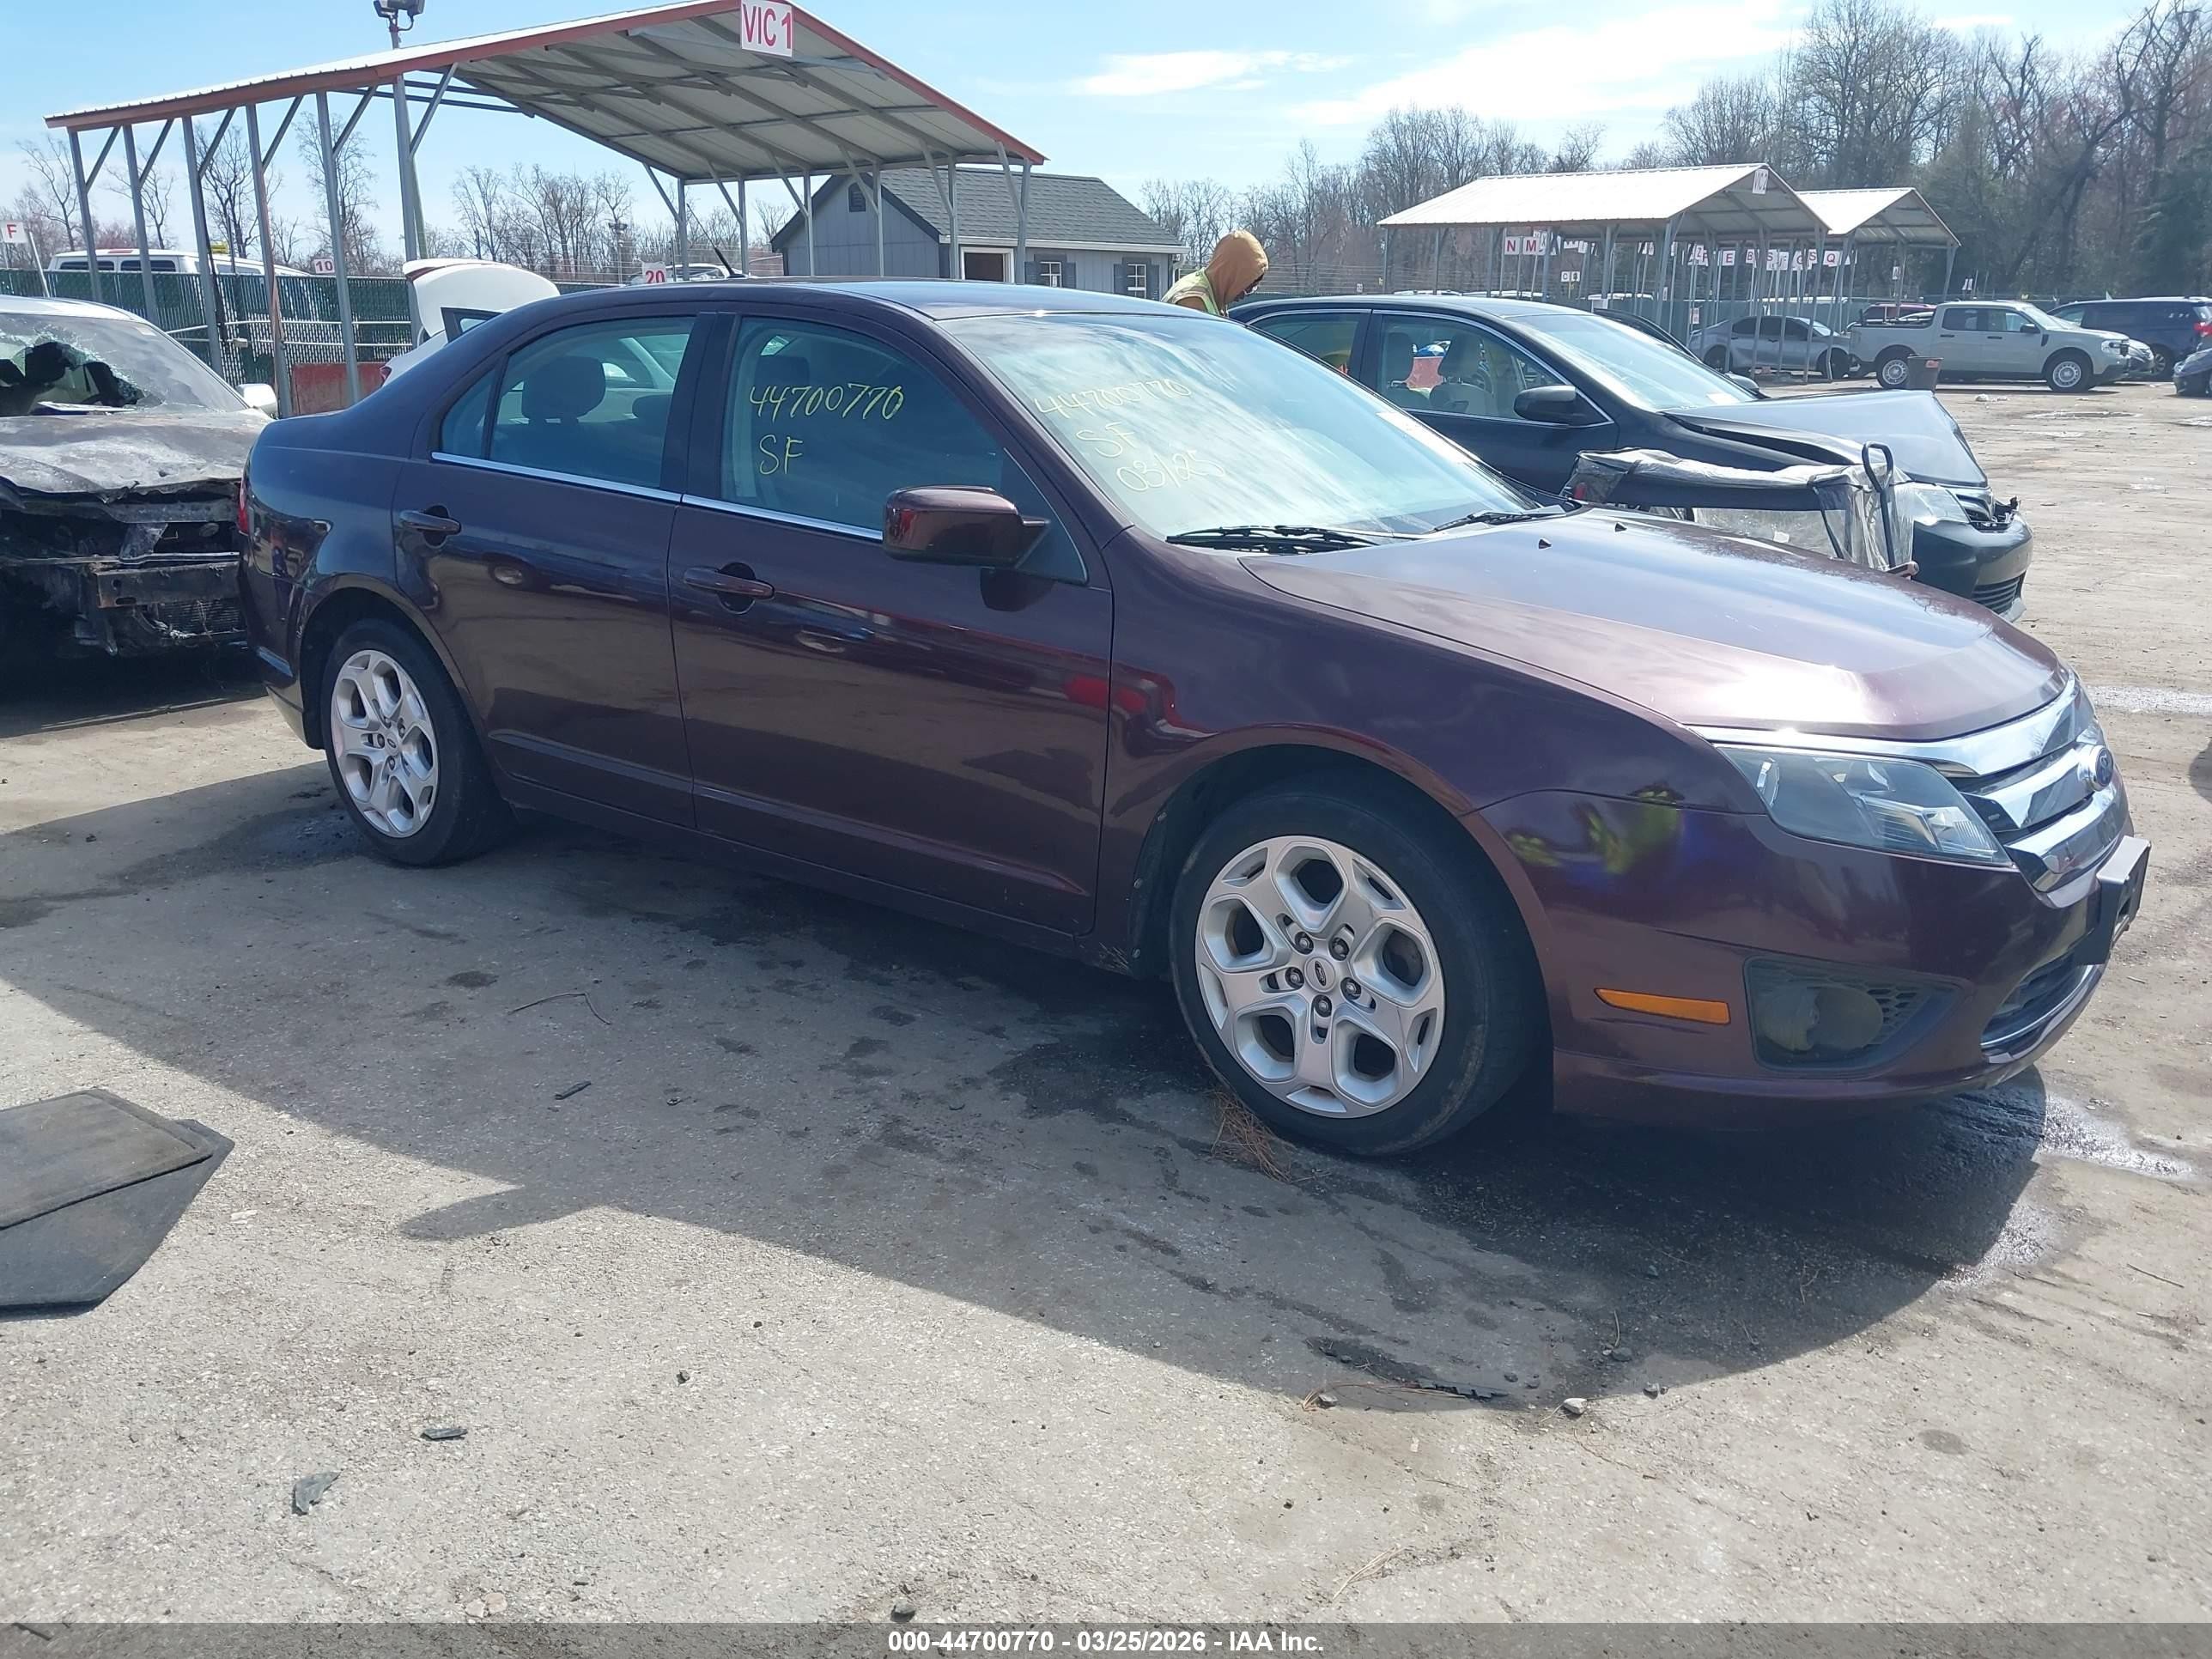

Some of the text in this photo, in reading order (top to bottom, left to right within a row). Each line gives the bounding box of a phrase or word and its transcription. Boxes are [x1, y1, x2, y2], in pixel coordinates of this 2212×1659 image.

[743, 3, 791, 49] VIC 1
[7, 224, 17, 239] F
[1506, 240, 1516, 252] N
[1525, 240, 1536, 252] M
[315, 260, 333, 271] 10
[1725, 253, 1733, 264] E
[1826, 253, 1836, 263] Q
[645, 270, 665, 283] 20
[749, 382, 904, 423] 44700770
[1034, 378, 1192, 419] 44700770
[1076, 422, 1138, 458] SF
[759, 434, 804, 476] SF
[1115, 449, 1226, 492] 03/25
